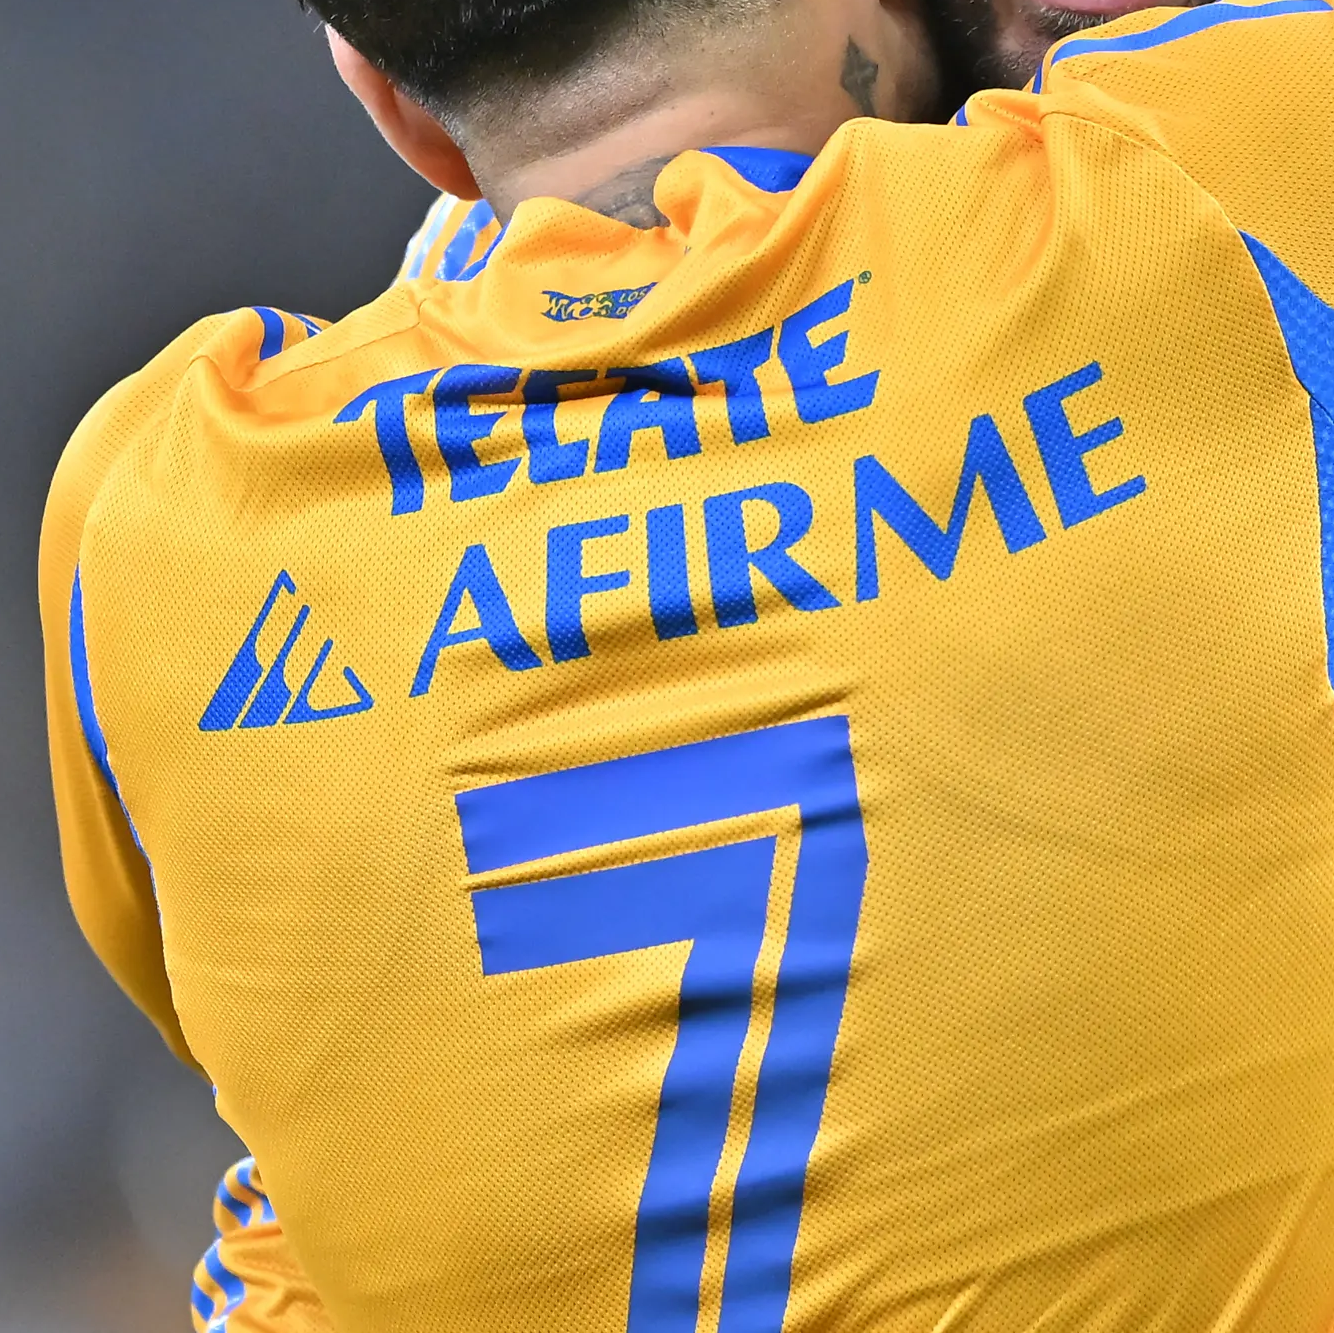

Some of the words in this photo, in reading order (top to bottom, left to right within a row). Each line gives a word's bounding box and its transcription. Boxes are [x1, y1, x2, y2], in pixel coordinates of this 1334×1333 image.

[334, 276, 882, 515] TECATE
[409, 361, 1147, 697] AFIRME
[455, 714, 869, 1333] 7
